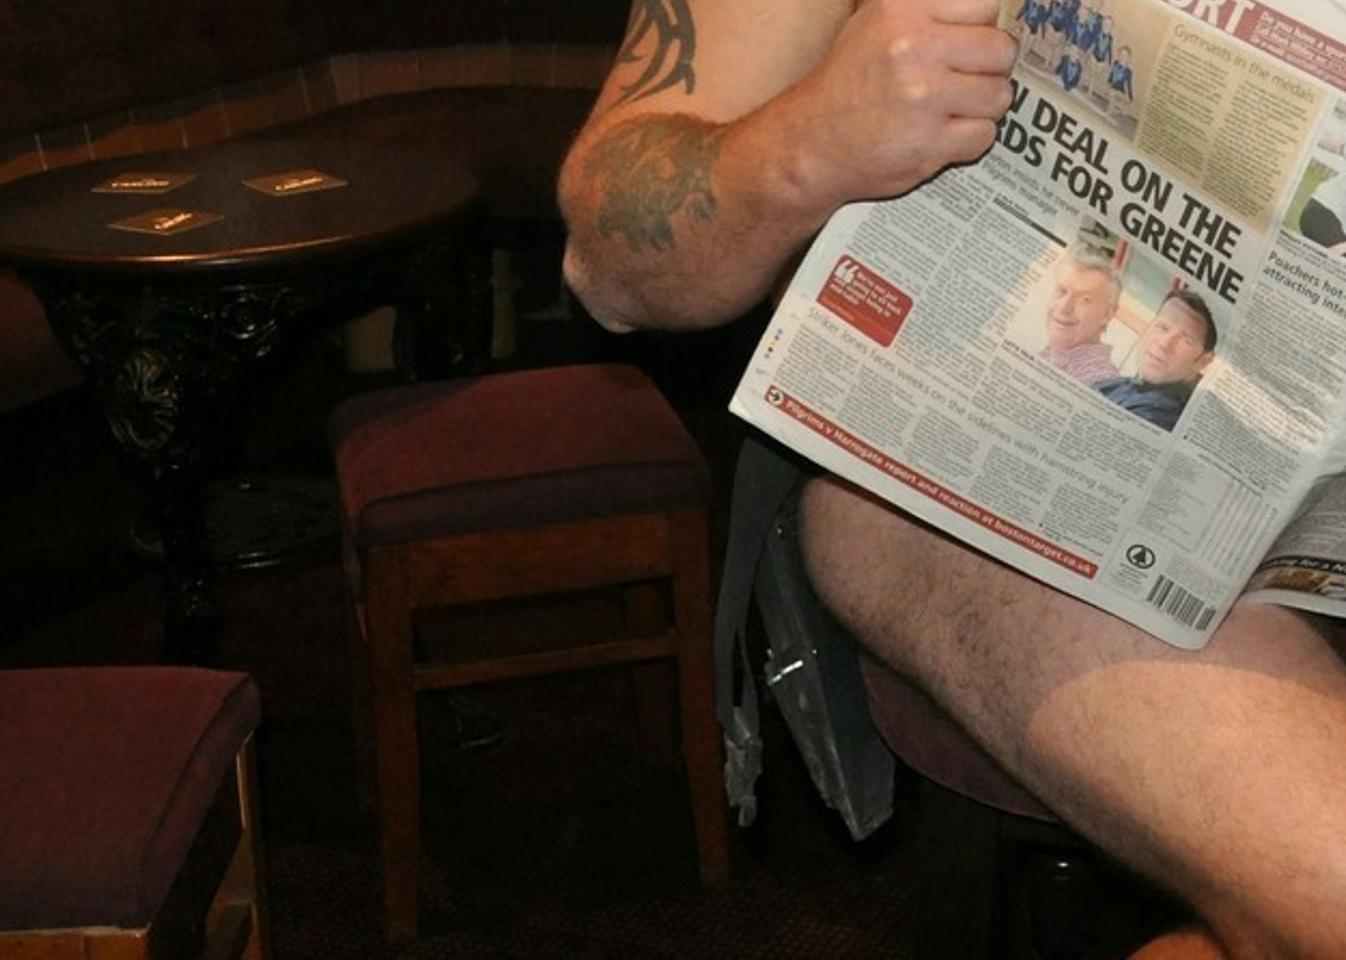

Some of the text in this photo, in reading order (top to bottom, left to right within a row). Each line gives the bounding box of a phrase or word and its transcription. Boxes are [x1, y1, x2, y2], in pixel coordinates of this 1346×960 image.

[1031, 98, 1108, 175] DEAL
[1121, 160, 1174, 212] ON
[1178, 193, 1241, 259] THE
[1051, 152, 1114, 216] FOR
[1120, 202, 1243, 304] GREENE
[1261, 264, 1321, 304] attracting
[1266, 250, 1322, 287] Poachers
[866, 348, 898, 373] faces
[894, 367, 932, 395] weeks
[929, 389, 947, 404] on
[945, 397, 967, 417] the
[965, 408, 1015, 444] sidelines
[1011, 434, 1043, 460] with
[784, 400, 824, 432] Pilgrims
[833, 429, 883, 468] Harrogate
[883, 455, 918, 488] report
[917, 474, 939, 494] and
[938, 487, 982, 518] reaction
[982, 511, 994, 525] at
[995, 516, 1094, 575] bostontarget.co.uk
